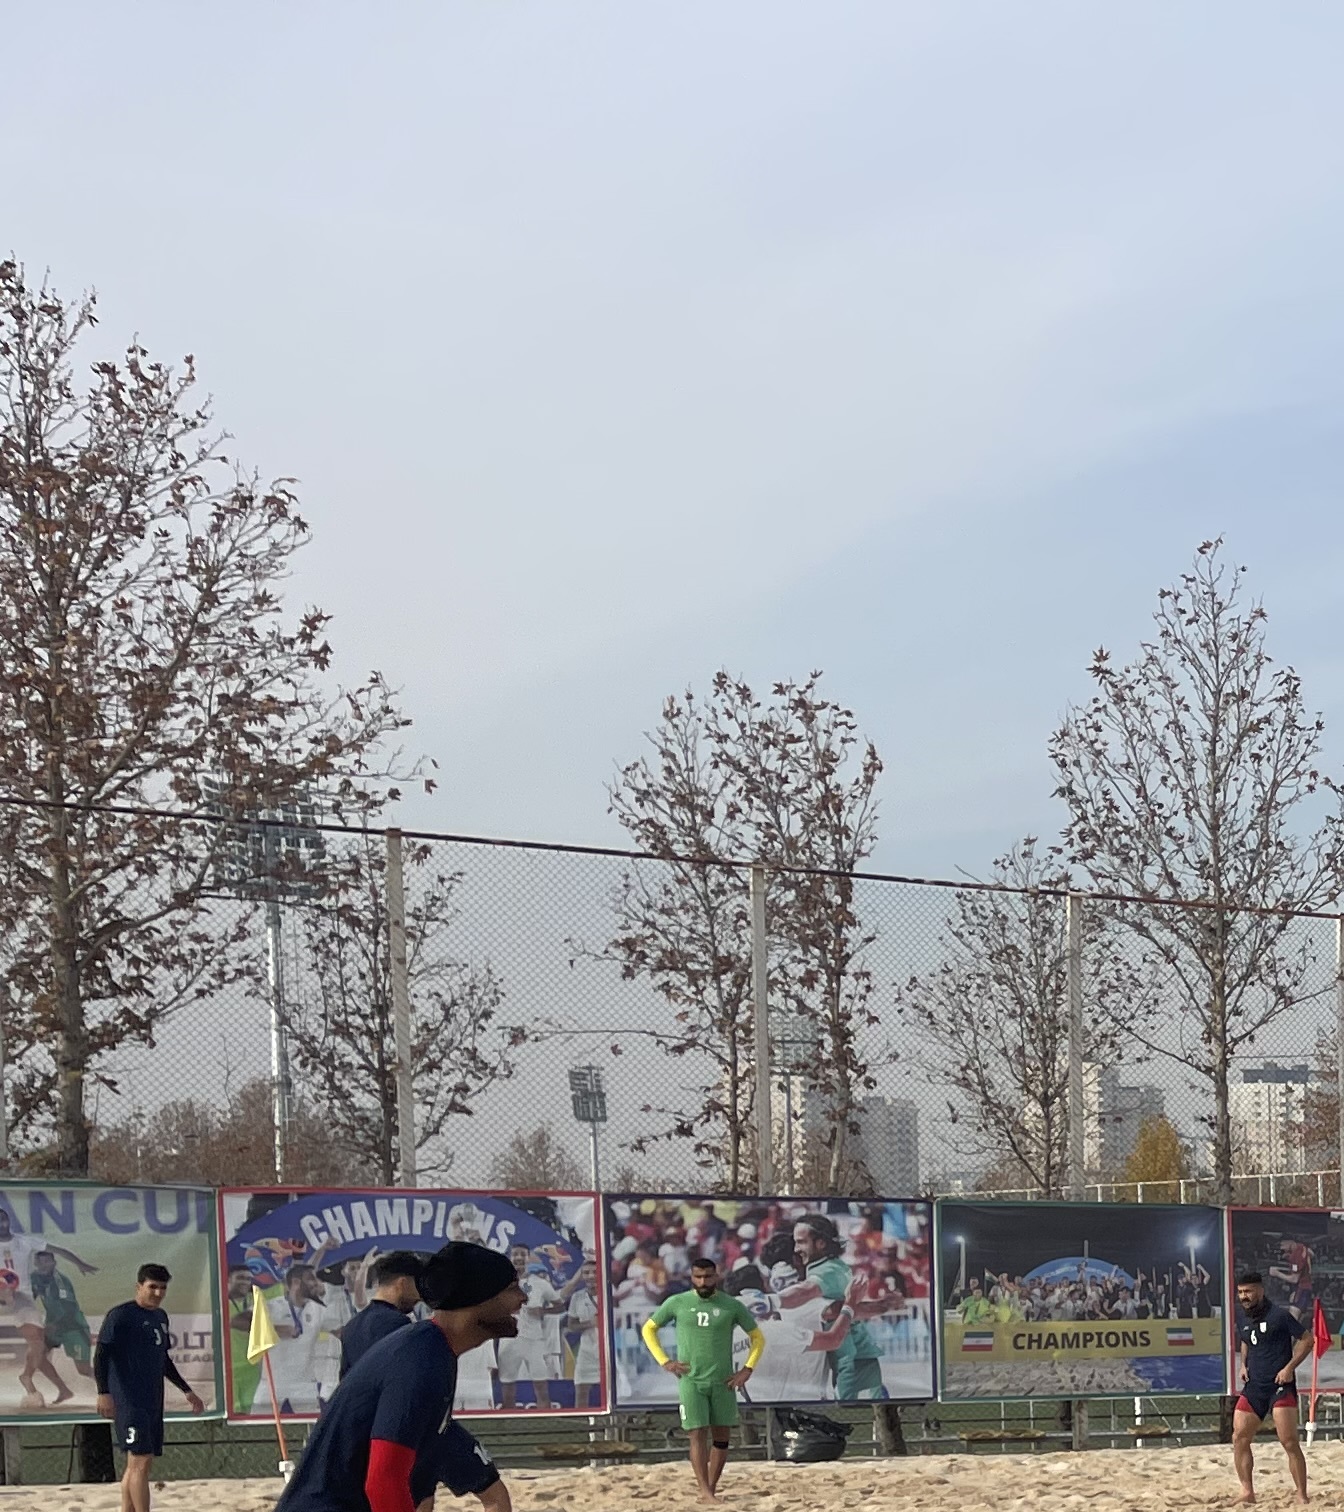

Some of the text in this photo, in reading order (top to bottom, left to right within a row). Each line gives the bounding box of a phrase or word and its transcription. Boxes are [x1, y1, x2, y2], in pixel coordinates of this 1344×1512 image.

[697, 1312, 709, 1327] 12
[1012, 1330, 1151, 1350] CHAMPIONS
[1250, 1330, 1258, 1345] 6
[126, 1426, 136, 1444] 3
